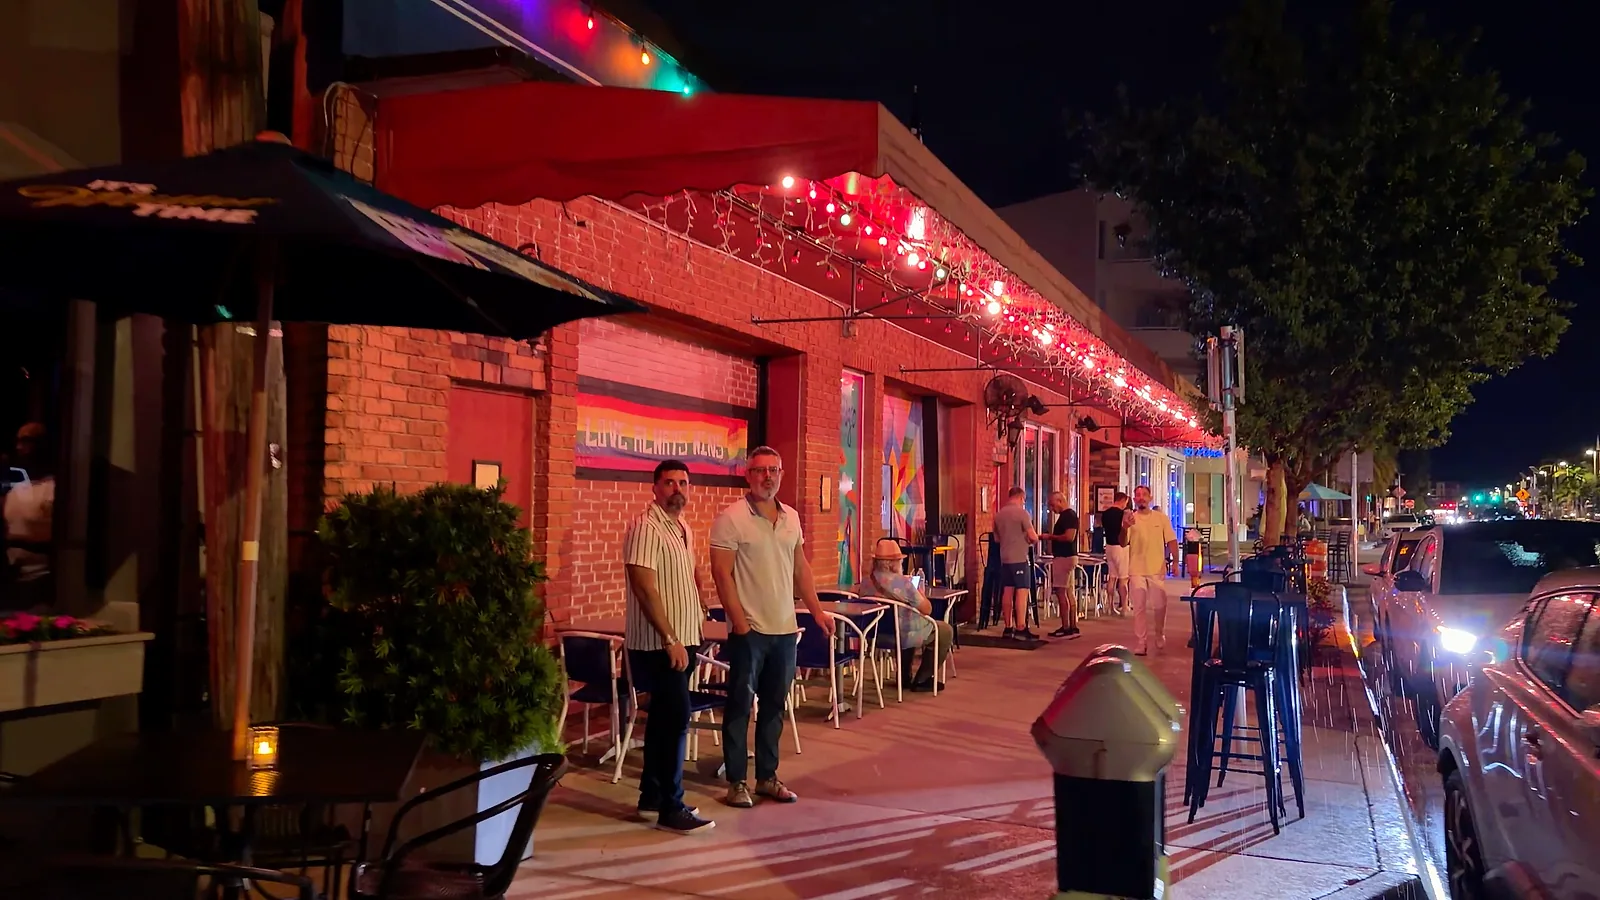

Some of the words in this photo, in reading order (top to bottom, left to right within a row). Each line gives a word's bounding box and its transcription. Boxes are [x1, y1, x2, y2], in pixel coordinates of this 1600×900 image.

[584, 417, 628, 450] LOVE
[633, 424, 688, 457] ALWAYS
[692, 429, 724, 460] WINS
